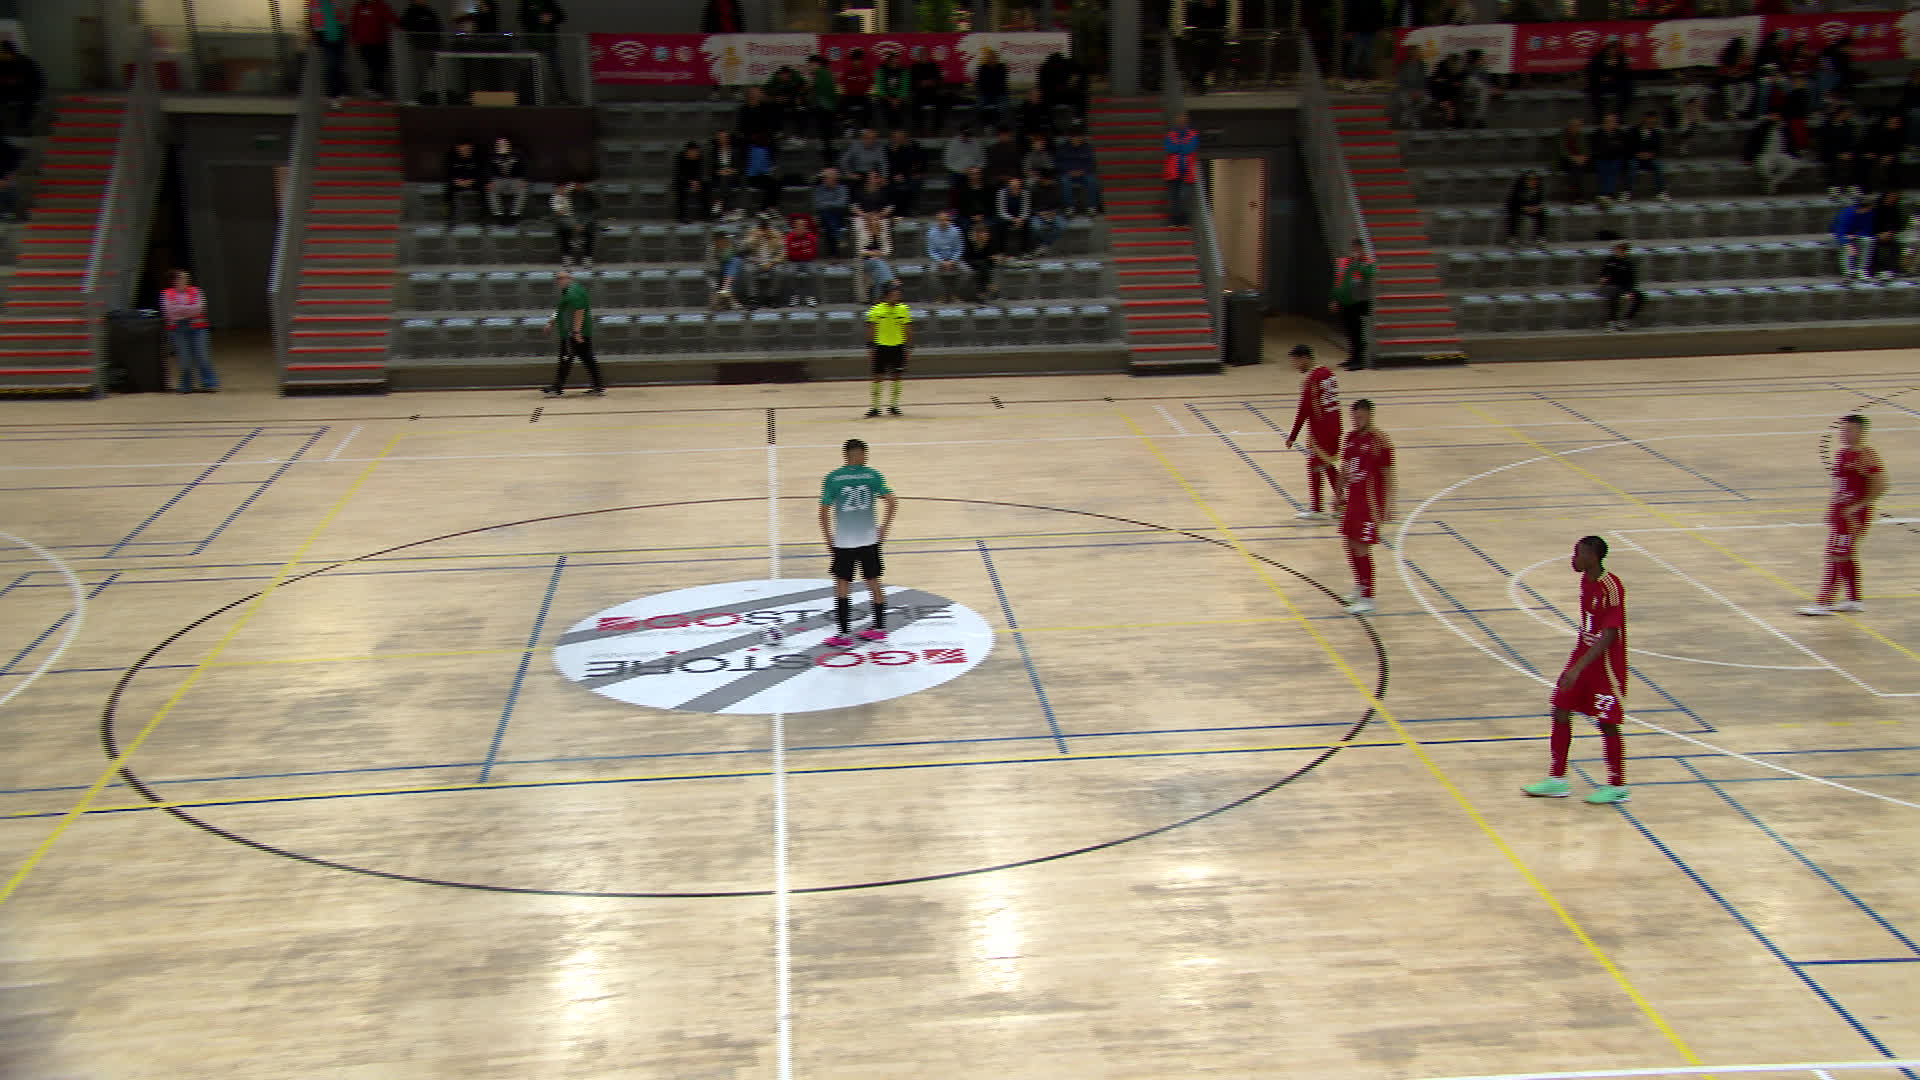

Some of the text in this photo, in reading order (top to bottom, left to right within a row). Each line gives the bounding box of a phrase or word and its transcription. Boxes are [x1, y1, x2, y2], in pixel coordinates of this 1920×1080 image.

[745, 41, 812, 57] Province
[841, 484, 871, 512] 20
[1594, 693, 1616, 712] 27
